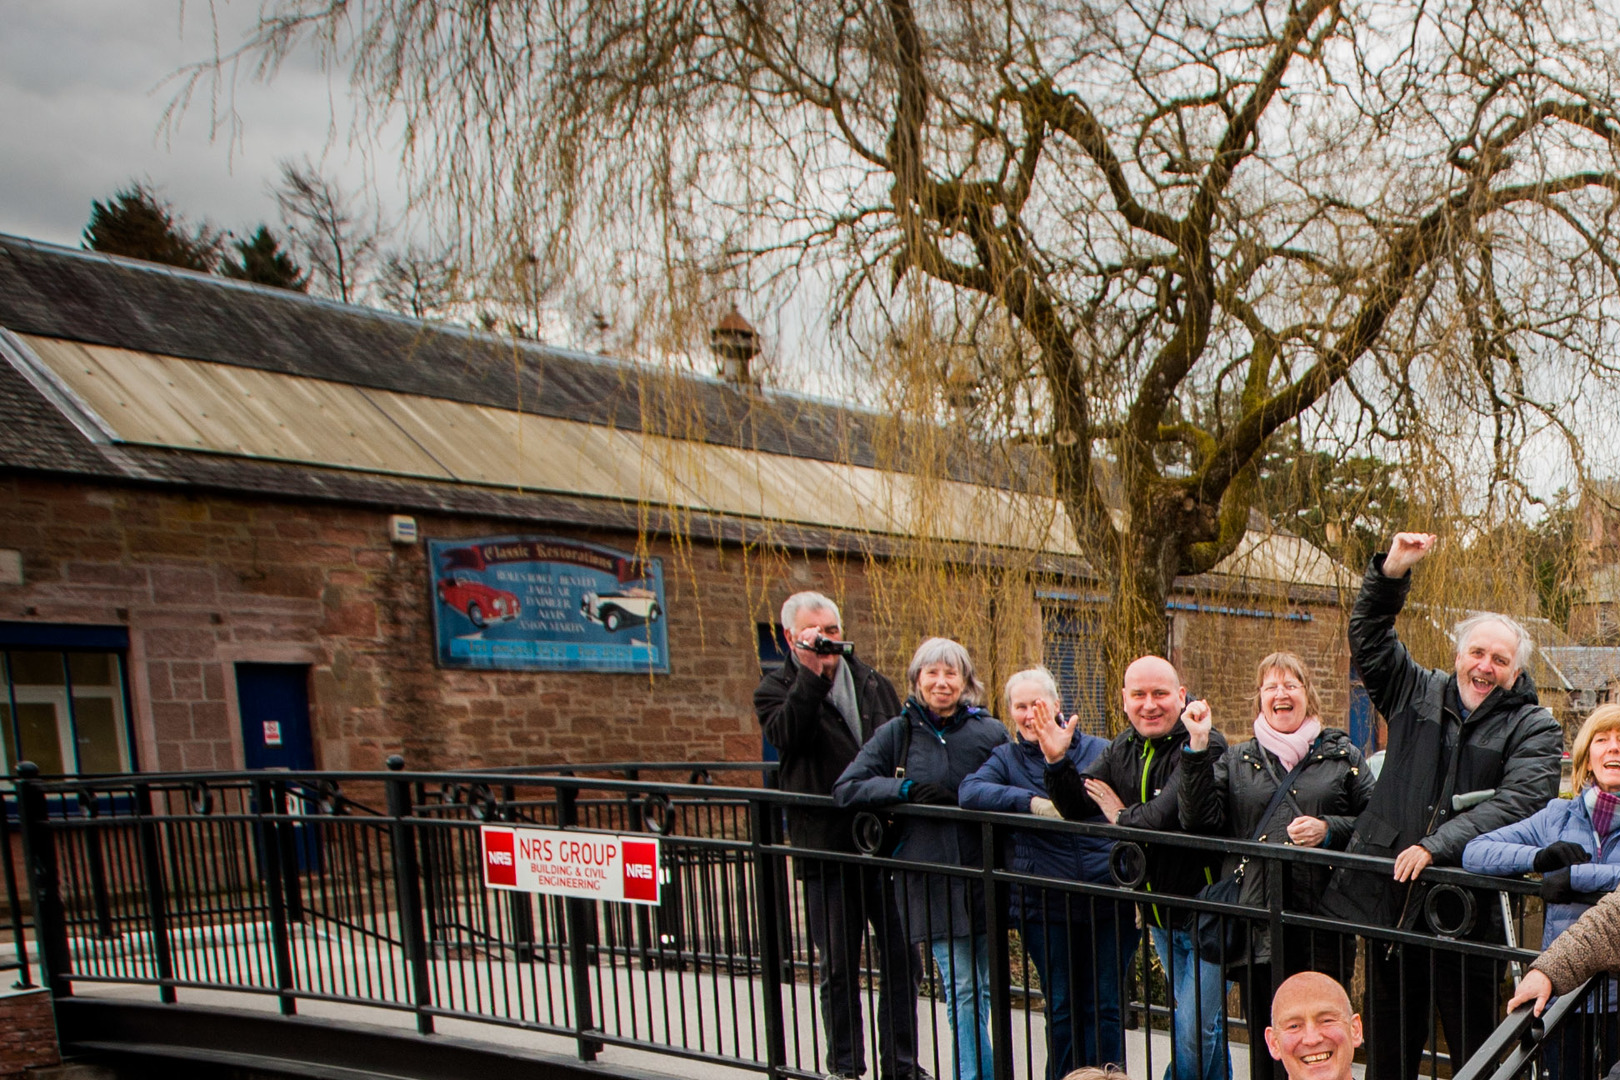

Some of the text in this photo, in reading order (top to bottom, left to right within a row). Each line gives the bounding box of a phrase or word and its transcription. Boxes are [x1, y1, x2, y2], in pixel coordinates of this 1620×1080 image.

[483, 543, 613, 569] Classic Restorations
[527, 584, 571, 597] JAGUAR
[488, 851, 512, 866] NRS
[520, 838, 616, 866] NRS GROUP
[531, 863, 607, 879] BUILDING & CIVIL
[626, 863, 653, 879] NRS
[539, 876, 600, 891] ENGINEERING
